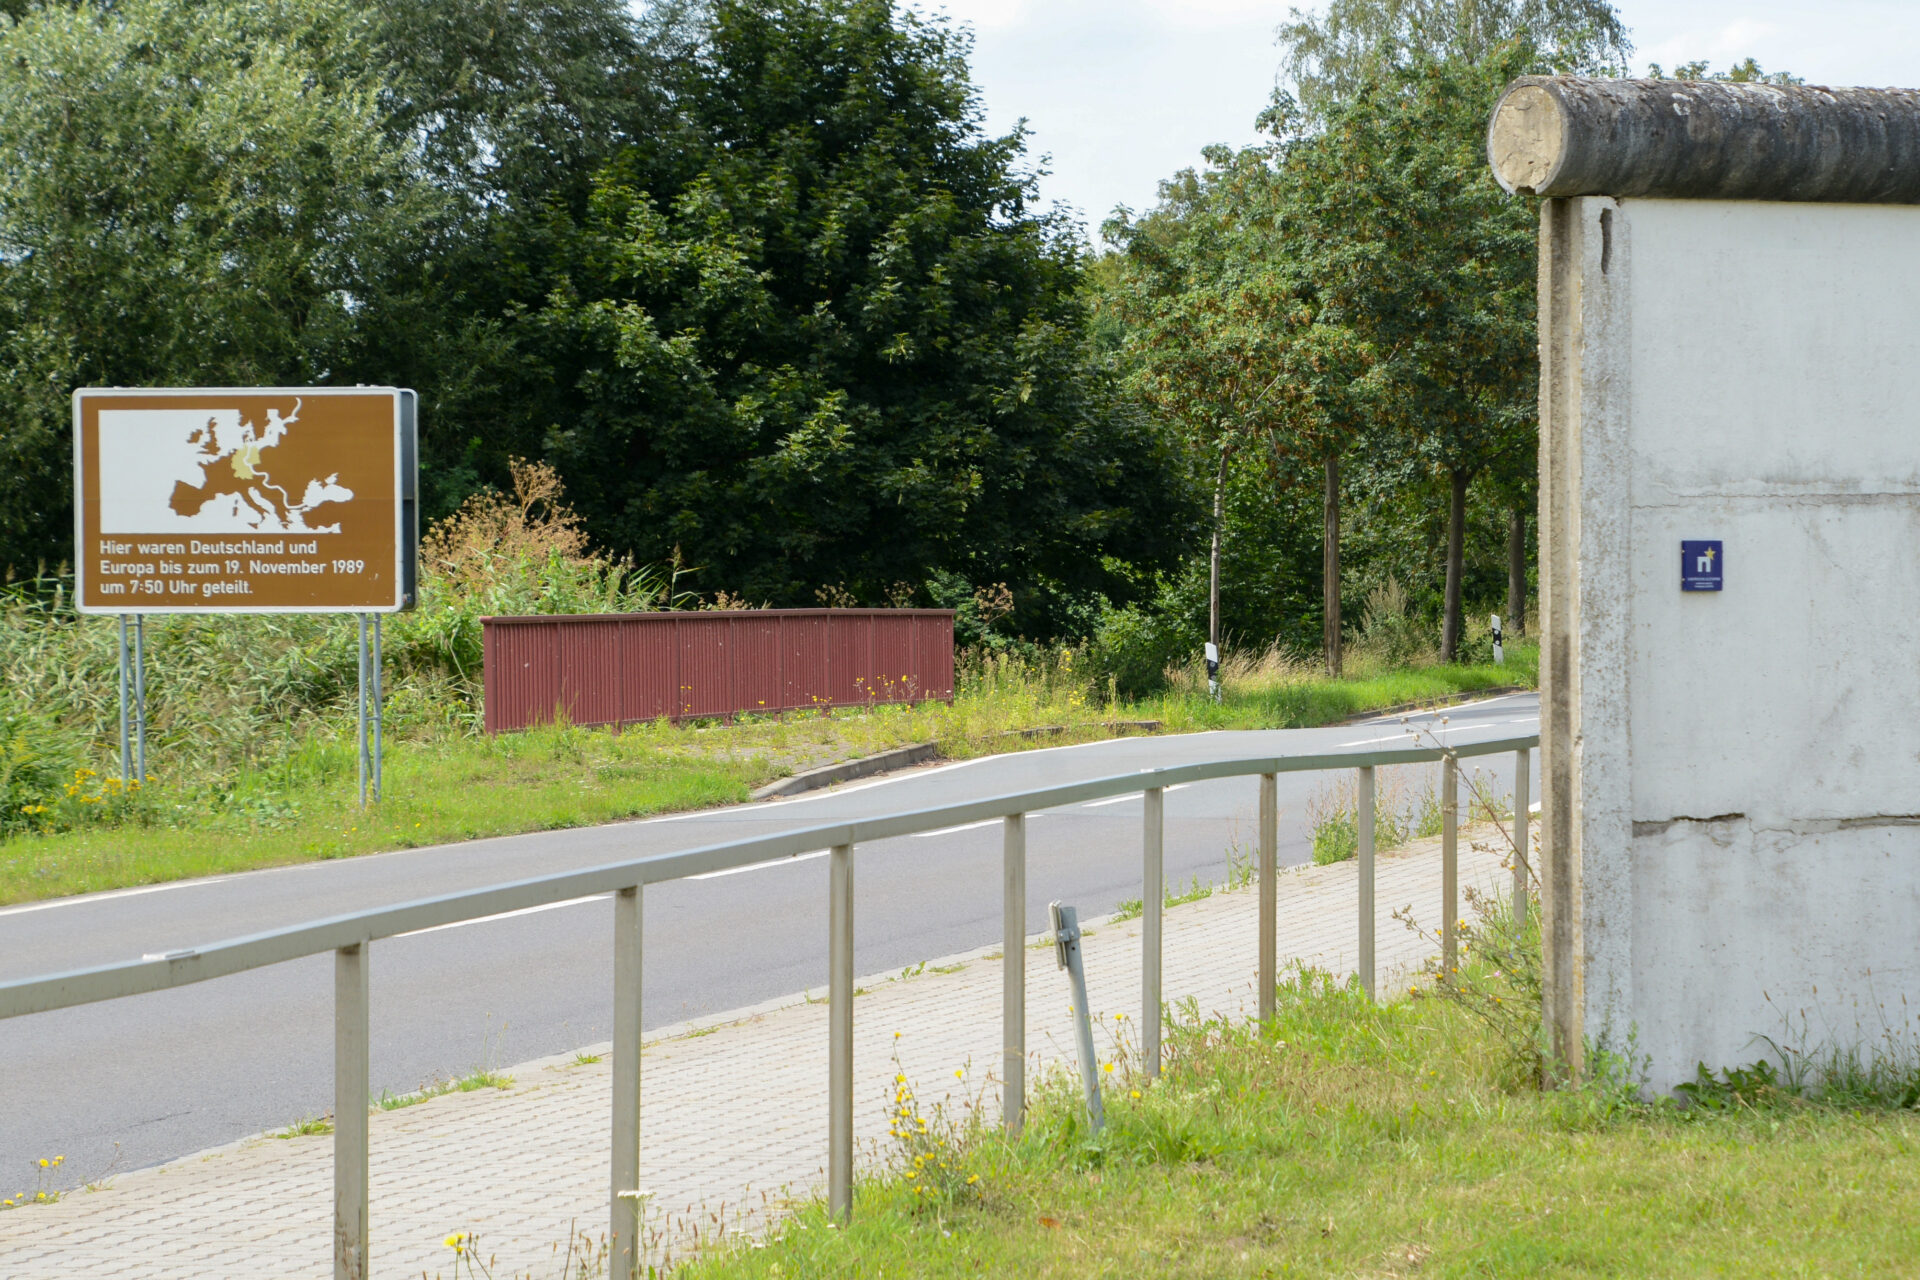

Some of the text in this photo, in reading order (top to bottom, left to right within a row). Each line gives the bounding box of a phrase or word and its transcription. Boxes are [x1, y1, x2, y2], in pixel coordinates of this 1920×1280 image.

[100, 540, 317, 555] Hier waren Deutschland und
[100, 560, 365, 577] Europa bis zum 19. November 1989
[100, 580, 254, 598] um 7:50 Uhr geteilt.
